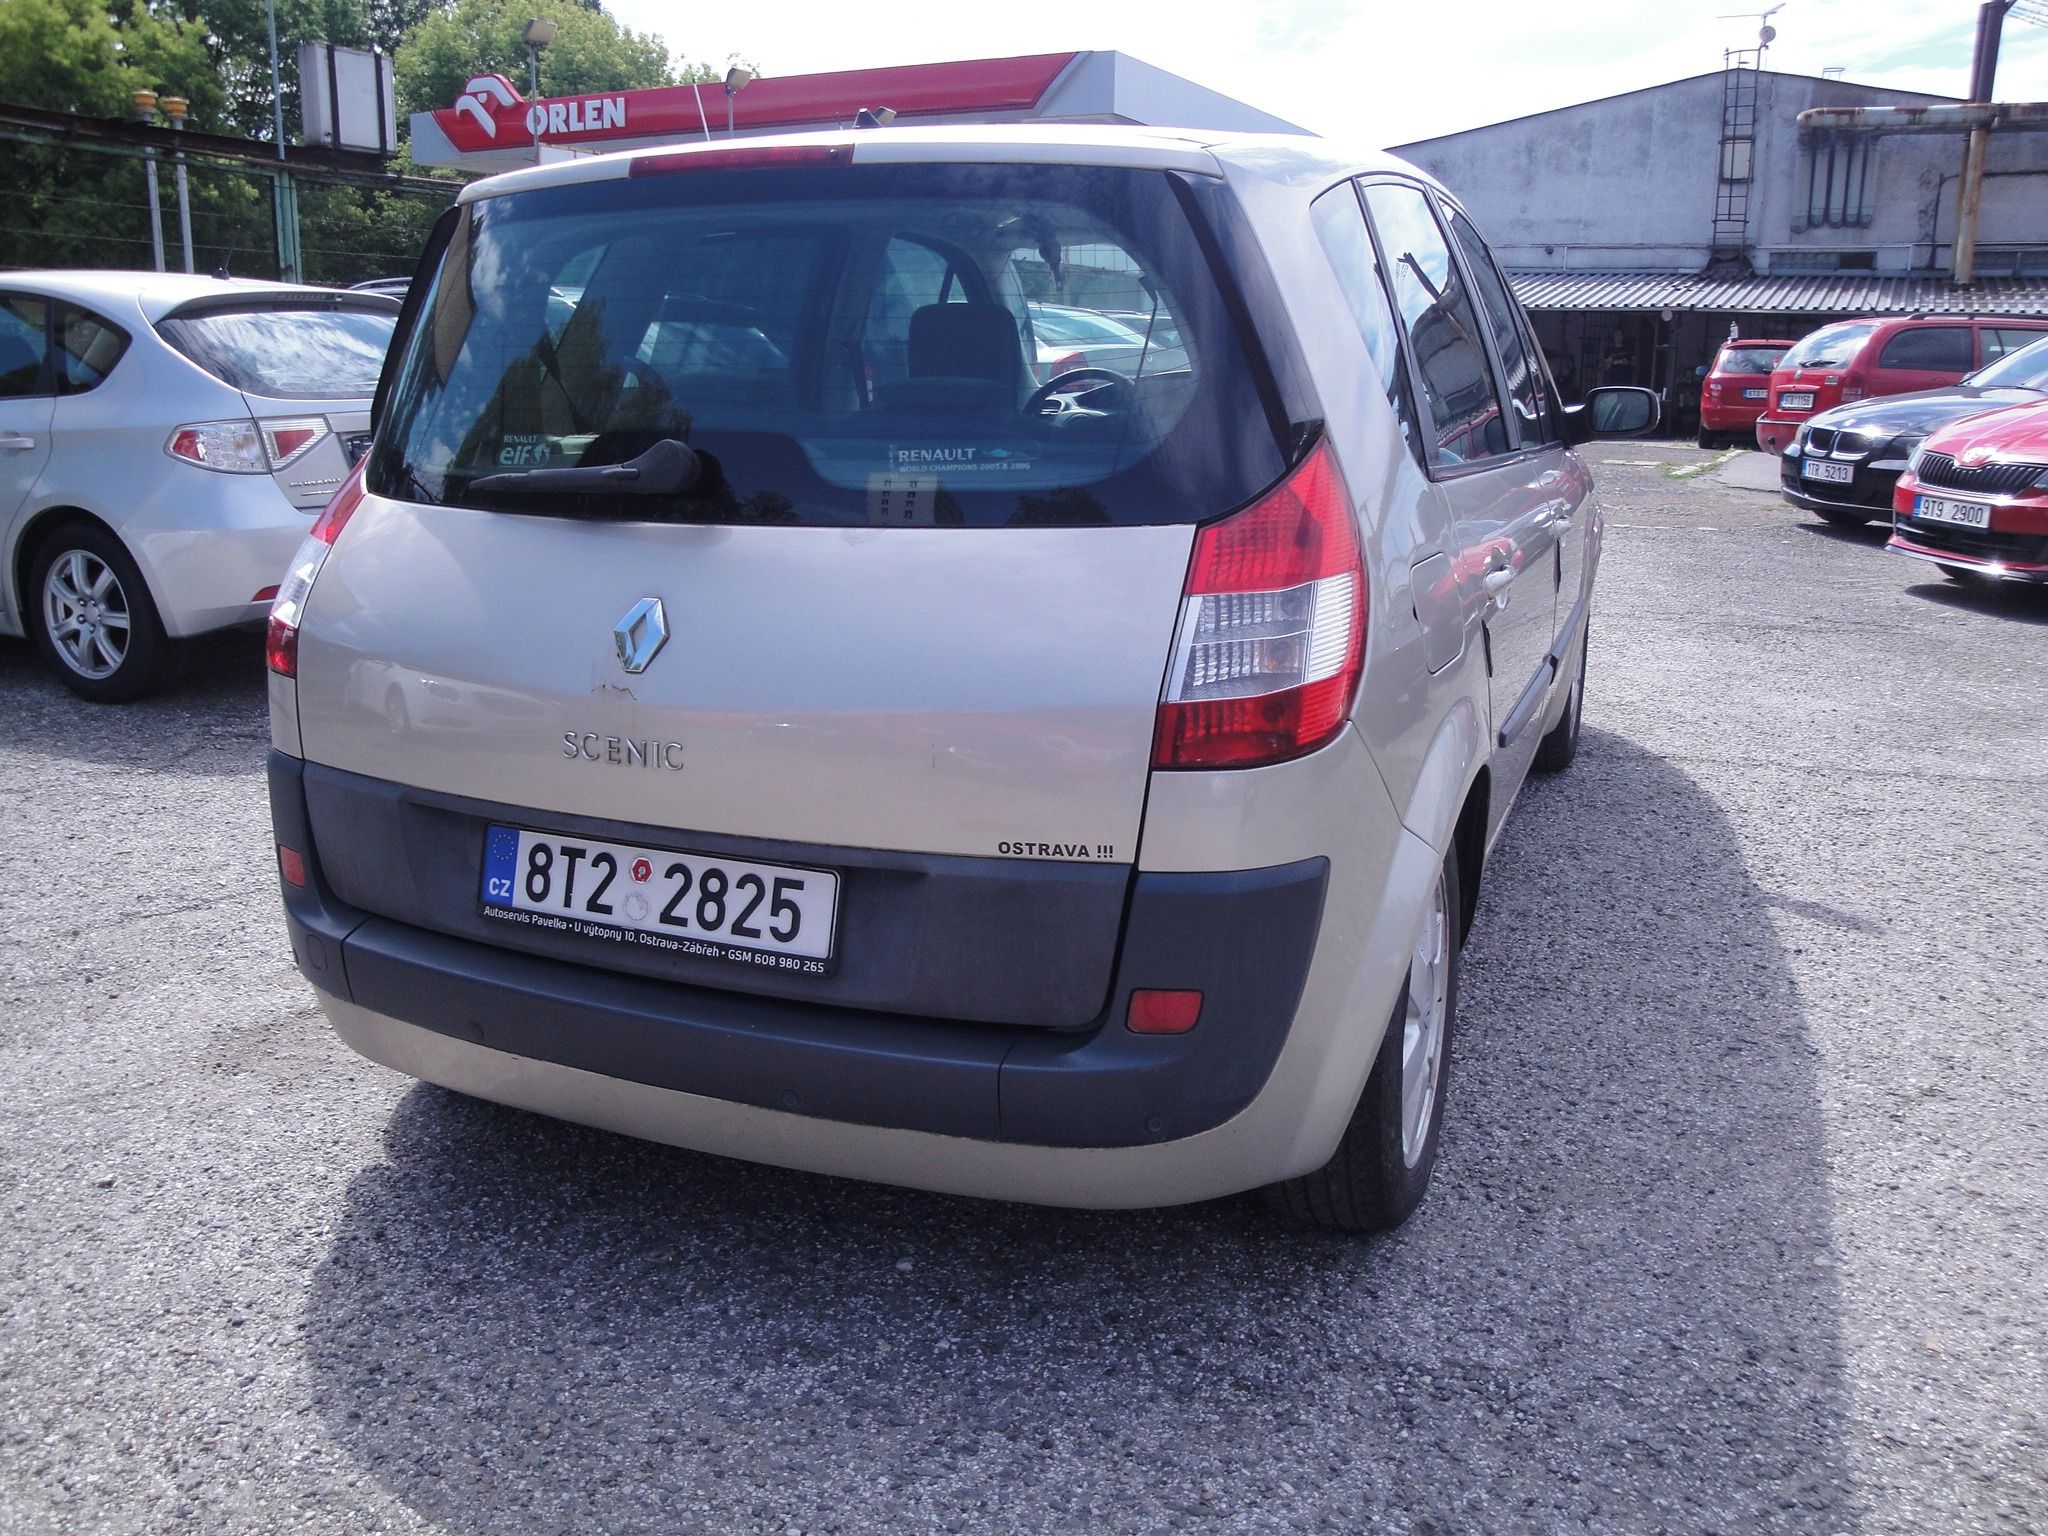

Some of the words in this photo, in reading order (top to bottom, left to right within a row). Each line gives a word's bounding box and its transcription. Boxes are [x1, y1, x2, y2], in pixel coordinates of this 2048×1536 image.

[526, 97, 626, 136] ORLEN
[504, 434, 537, 443] RENAULT
[500, 446, 532, 465] elf
[898, 447, 976, 462] RENAULT
[900, 464, 928, 473] WORLD
[929, 463, 977, 472] CHAMPIONS
[1825, 465, 1848, 480] 5213
[1922, 499, 1944, 517] 9T9
[1952, 504, 1984, 523] 2900
[562, 731, 684, 771] SCENIC
[998, 841, 1090, 858] OSTRAVA
[1097, 845, 1113, 858] !!!
[488, 877, 511, 897] CZ
[525, 843, 618, 915] 8T2
[659, 863, 805, 943] 2825
[483, 906, 530, 923] Autoservis
[532, 915, 567, 930] Pavelka
[574, 921, 582, 932] U
[583, 922, 622, 941] výtopny
[640, 932, 719, 958] Ostrava-Zábřeh
[728, 949, 752, 963] GSM
[754, 954, 776, 967] 608
[779, 957, 801, 970] 980
[803, 961, 825, 973] 265
